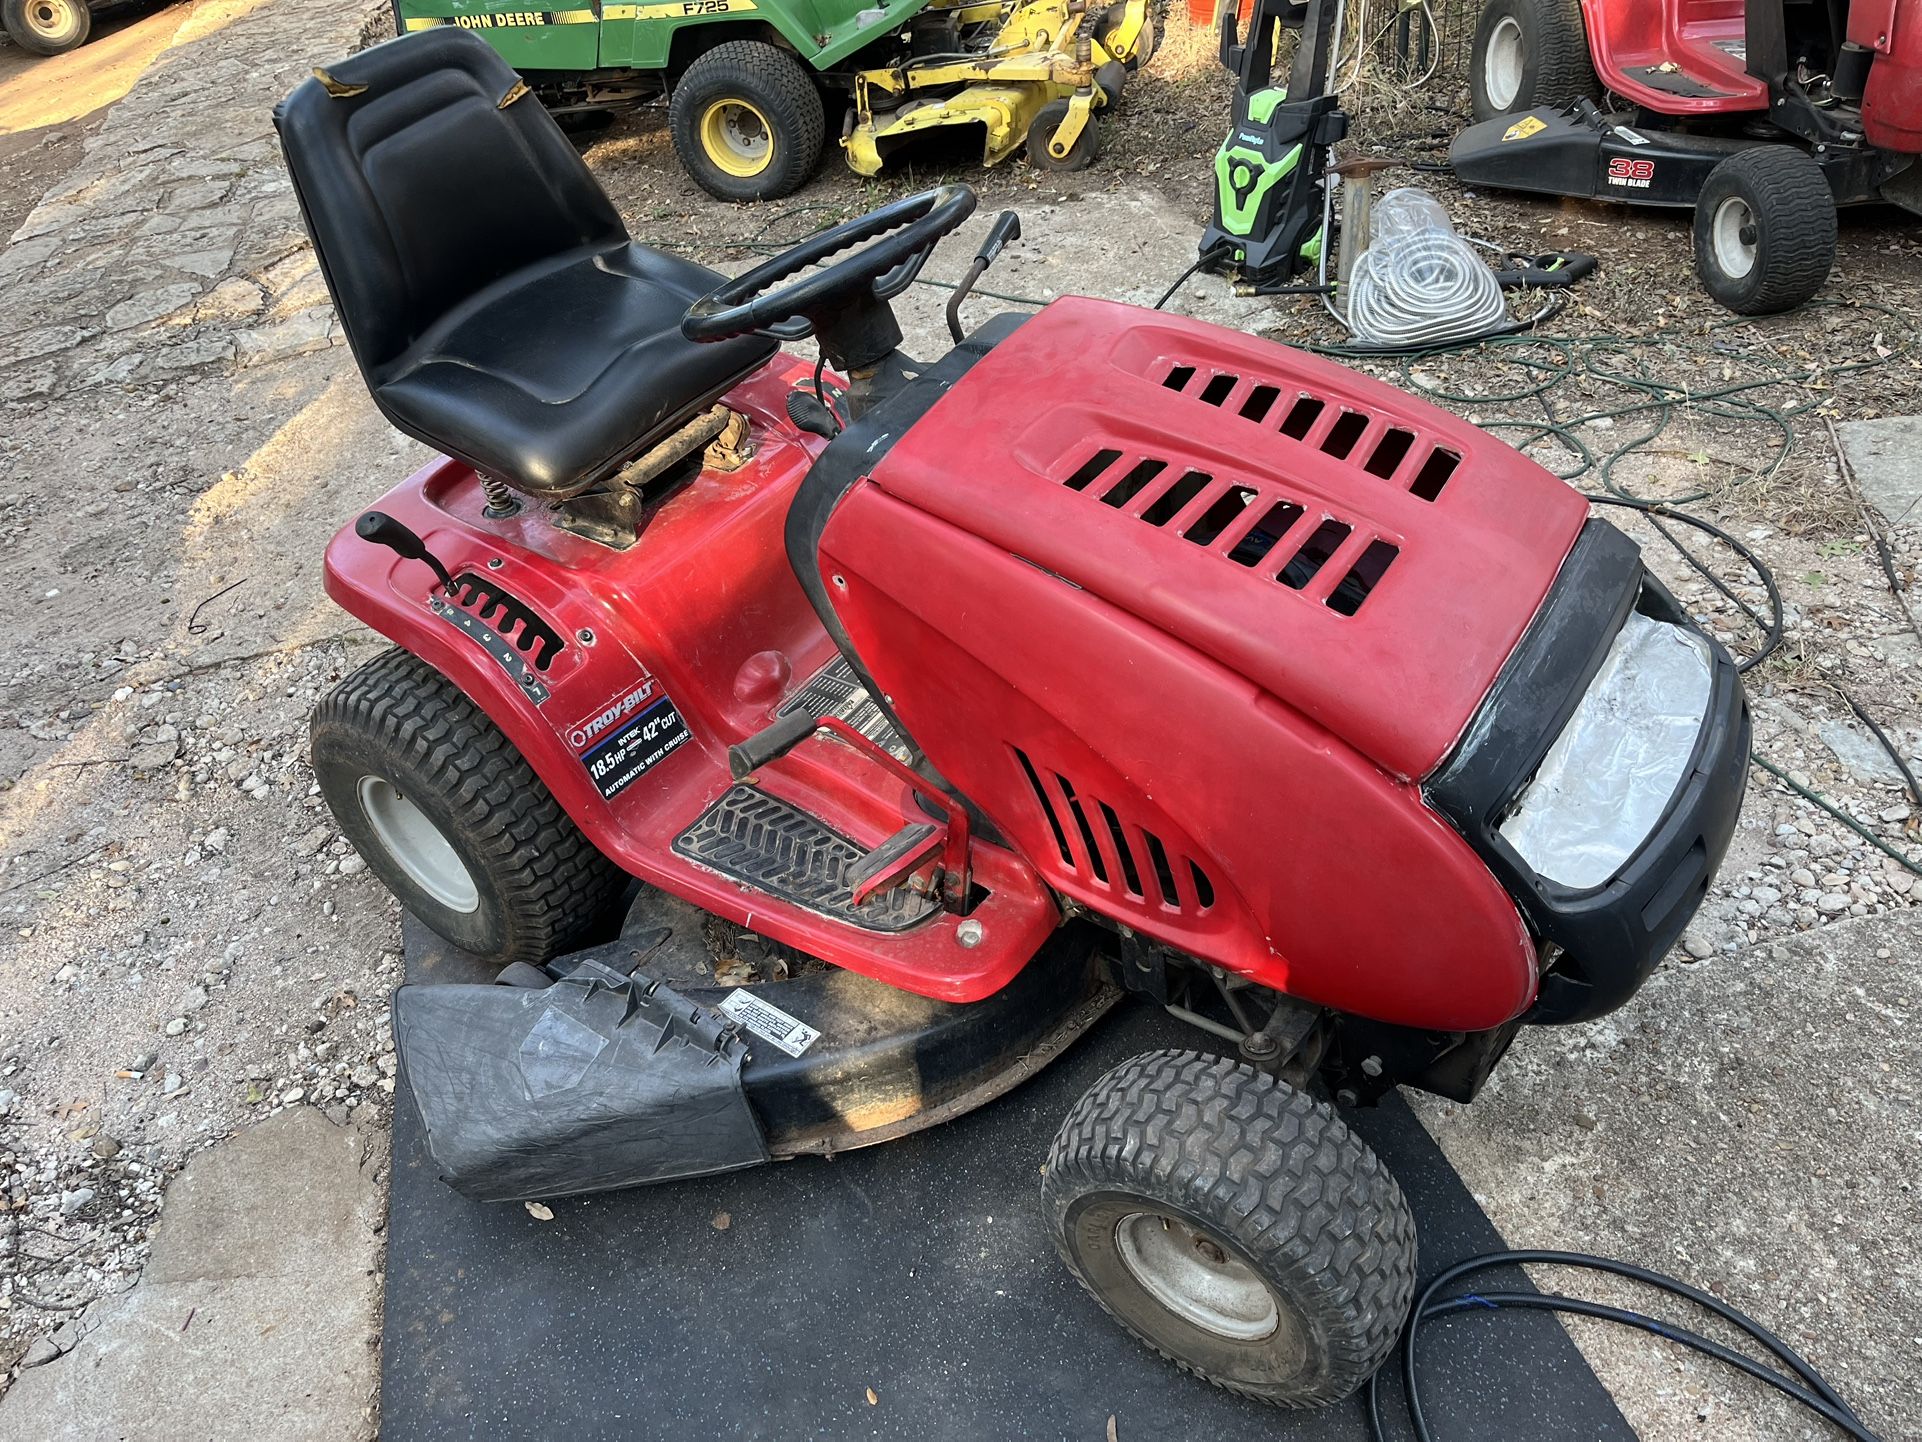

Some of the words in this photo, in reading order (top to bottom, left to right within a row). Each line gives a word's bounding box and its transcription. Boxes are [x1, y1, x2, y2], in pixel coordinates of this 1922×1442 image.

[683, 0, 729, 15] F725
[453, 15, 493, 29] JOHN
[495, 12, 545, 27] DEERE
[1609, 158, 1654, 179] 38
[1608, 176, 1627, 186] TWIN
[1627, 179, 1651, 188] BLADE
[482, 633, 492, 642] 3
[503, 652, 512, 662] 2
[583, 682, 654, 738] TROY-BILT
[590, 752, 616, 780] 18.5
[660, 712, 677, 730] CUT
[617, 726, 641, 747] INTEK
[605, 762, 646, 797] AUTOMATIC
[644, 749, 664, 766] WITH
[664, 730, 689, 751] CRUISE
